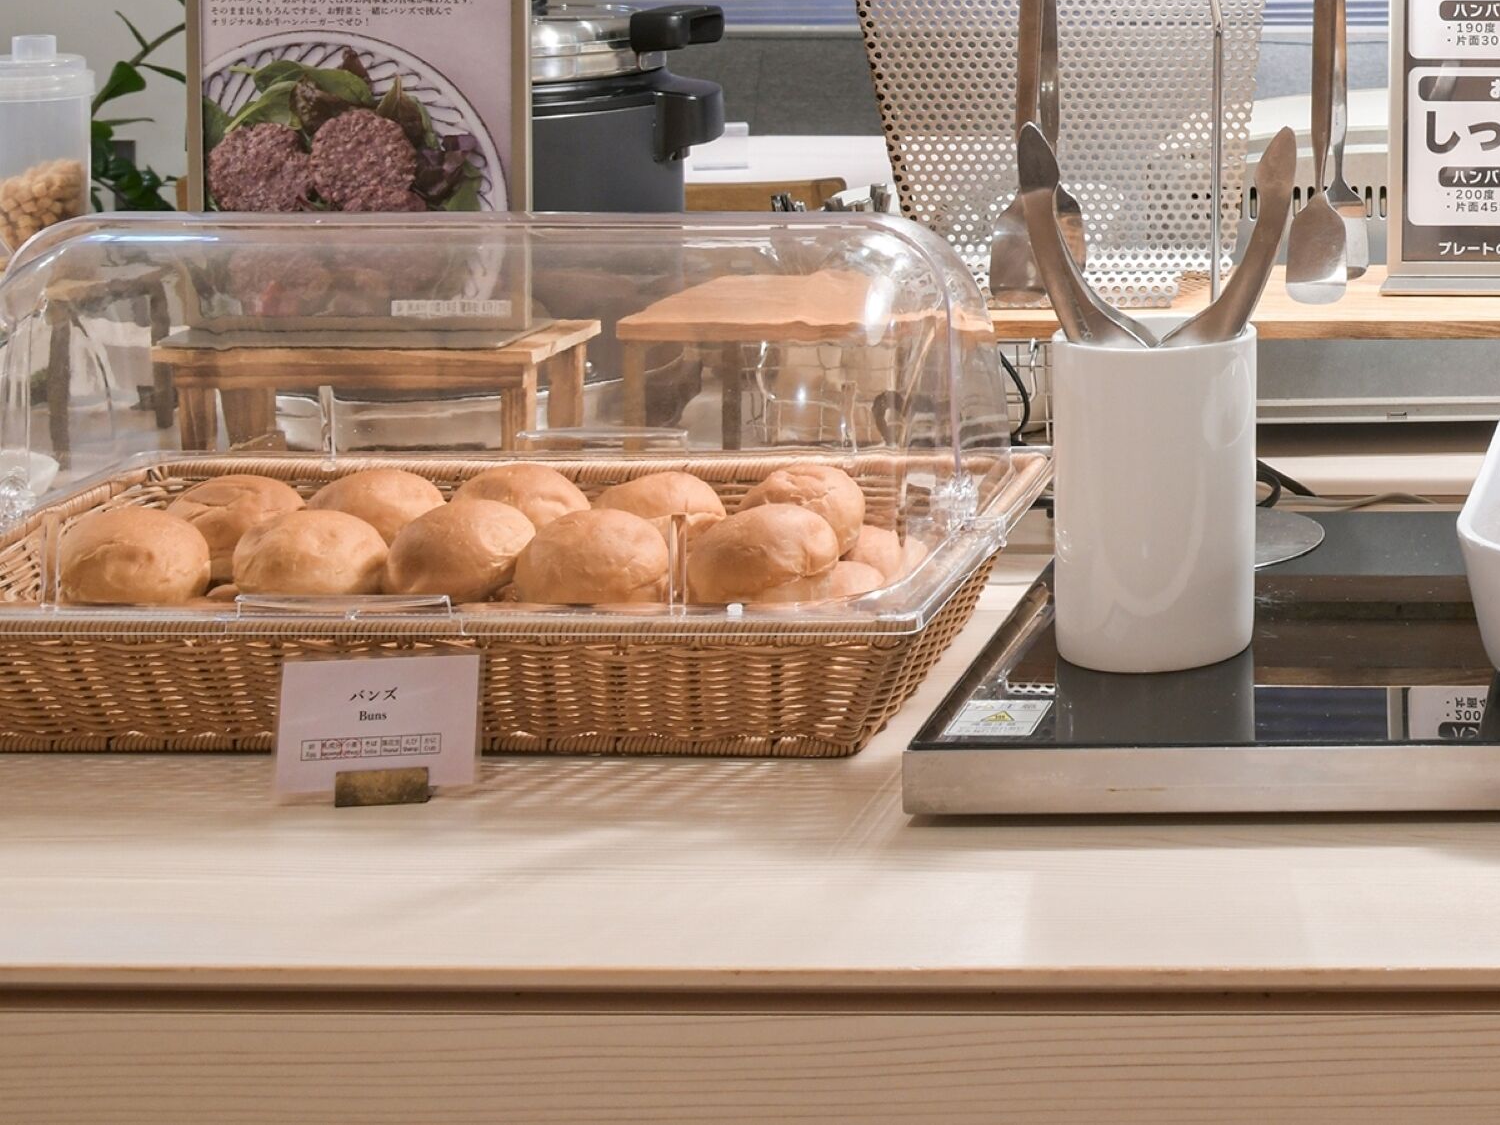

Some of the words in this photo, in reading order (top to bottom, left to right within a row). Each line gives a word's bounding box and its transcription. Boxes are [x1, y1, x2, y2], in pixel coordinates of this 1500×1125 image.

[350, 687, 397, 701] バンズ
[360, 711, 387, 721] Buns
